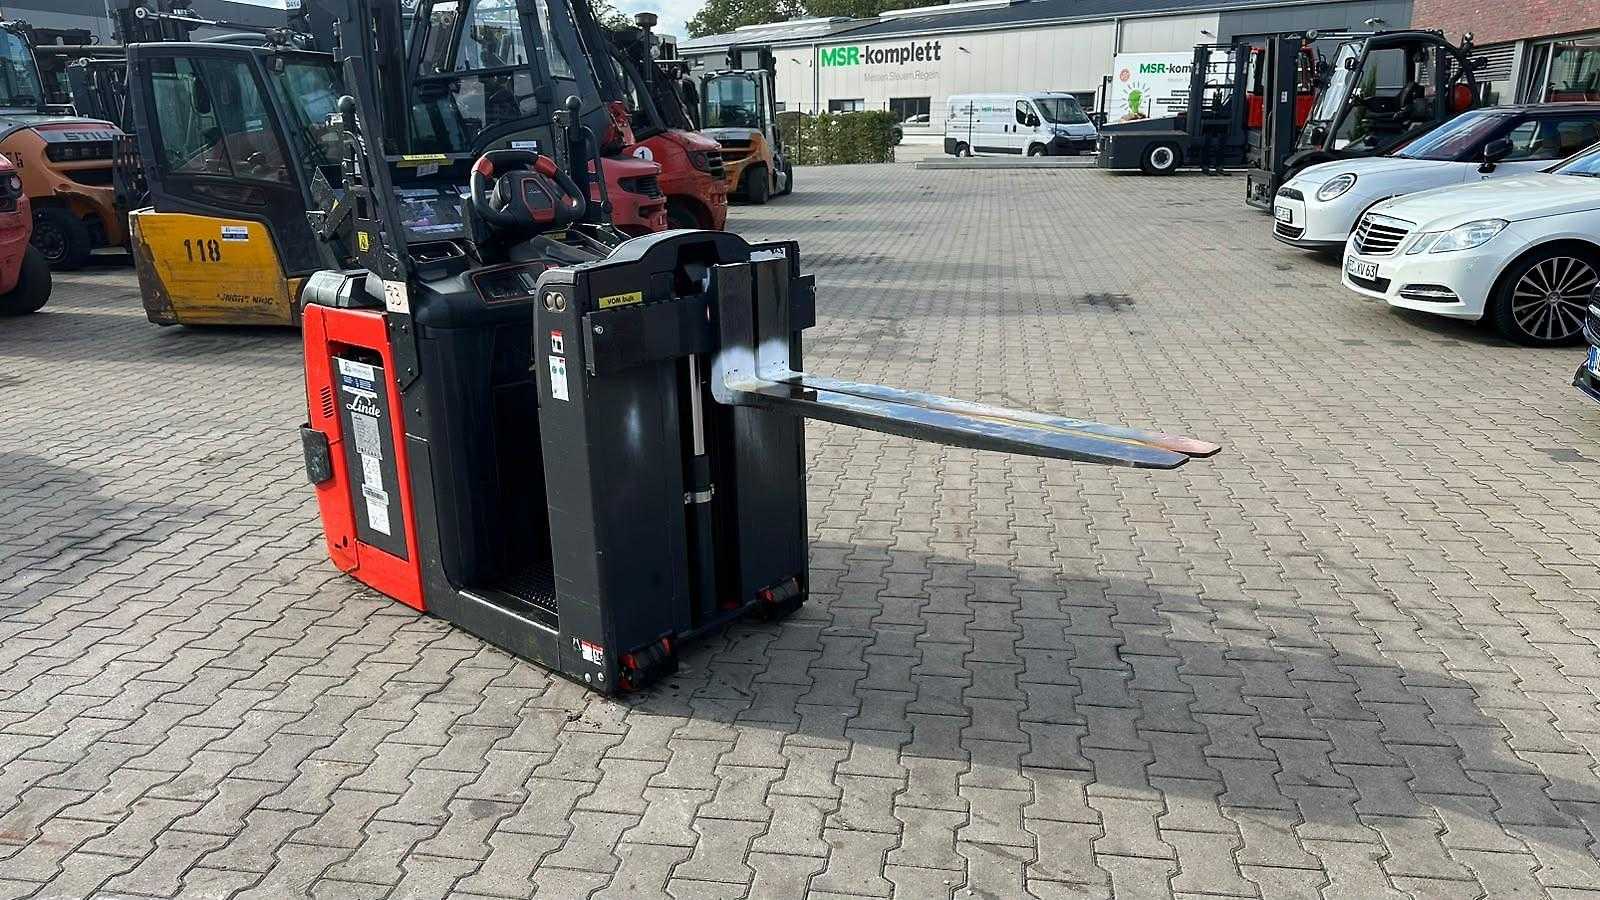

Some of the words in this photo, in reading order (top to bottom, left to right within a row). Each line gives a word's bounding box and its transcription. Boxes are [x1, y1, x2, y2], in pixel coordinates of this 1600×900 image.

[821, 40, 941, 68] MSR-komplett
[1139, 63, 1218, 74] MSR-komtt
[184, 239, 221, 262] 118
[1366, 264, 1376, 278] 63
[346, 395, 381, 417] Linde
